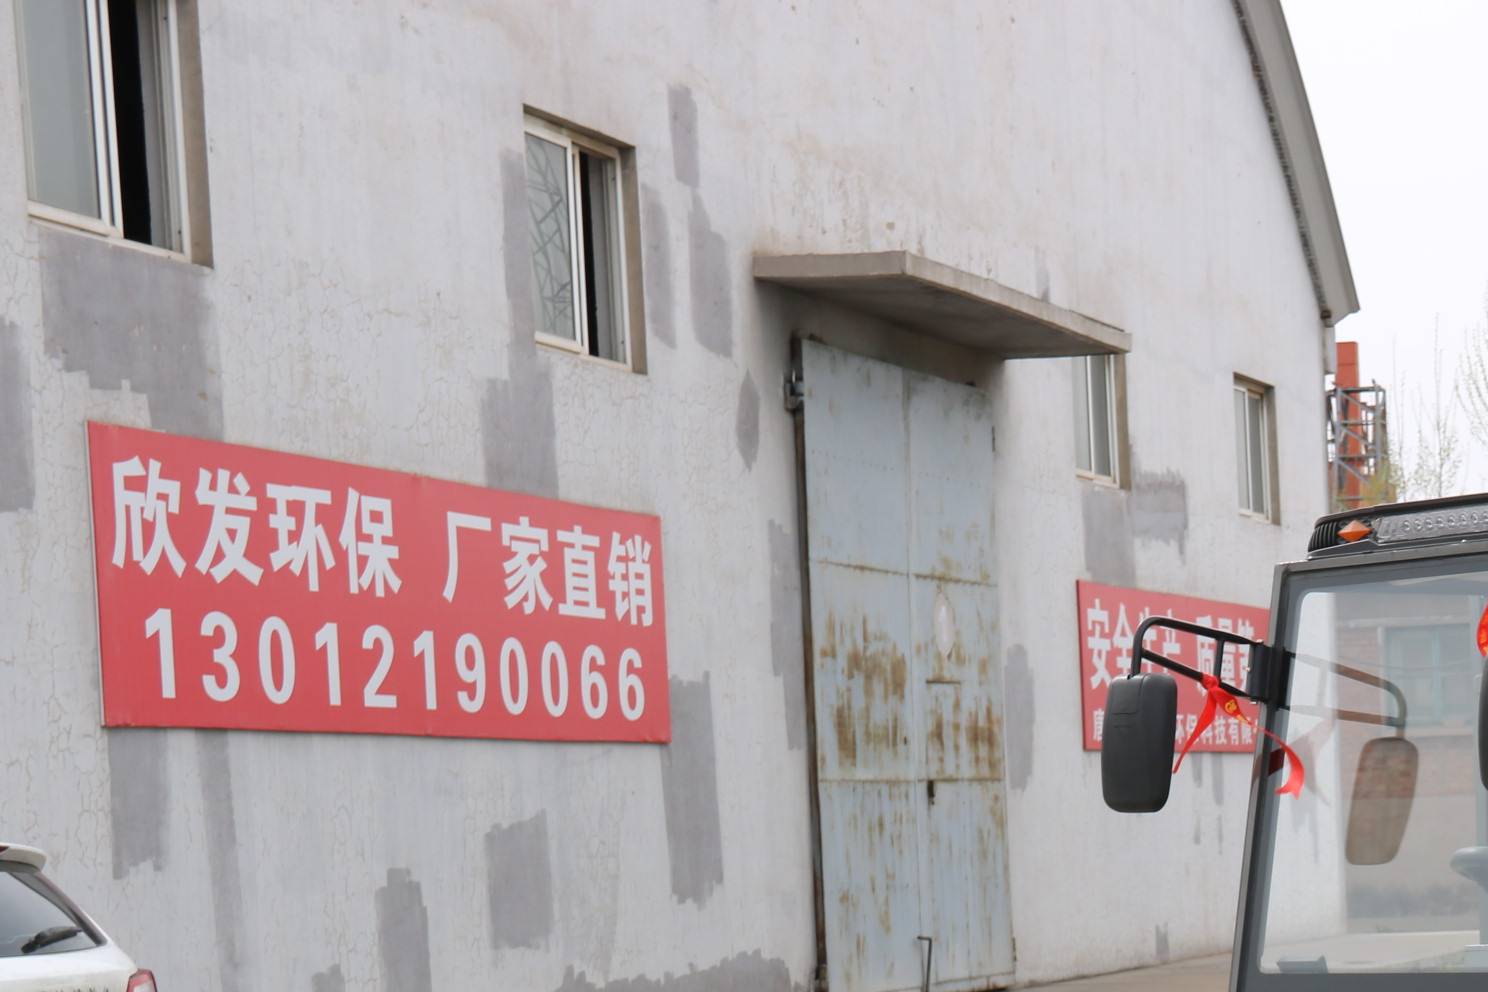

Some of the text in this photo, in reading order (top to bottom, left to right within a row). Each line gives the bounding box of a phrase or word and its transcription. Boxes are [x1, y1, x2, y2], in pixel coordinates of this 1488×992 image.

[112, 455, 654, 628] 欣发环保 厂家直销
[145, 608, 646, 721] 13012190066
